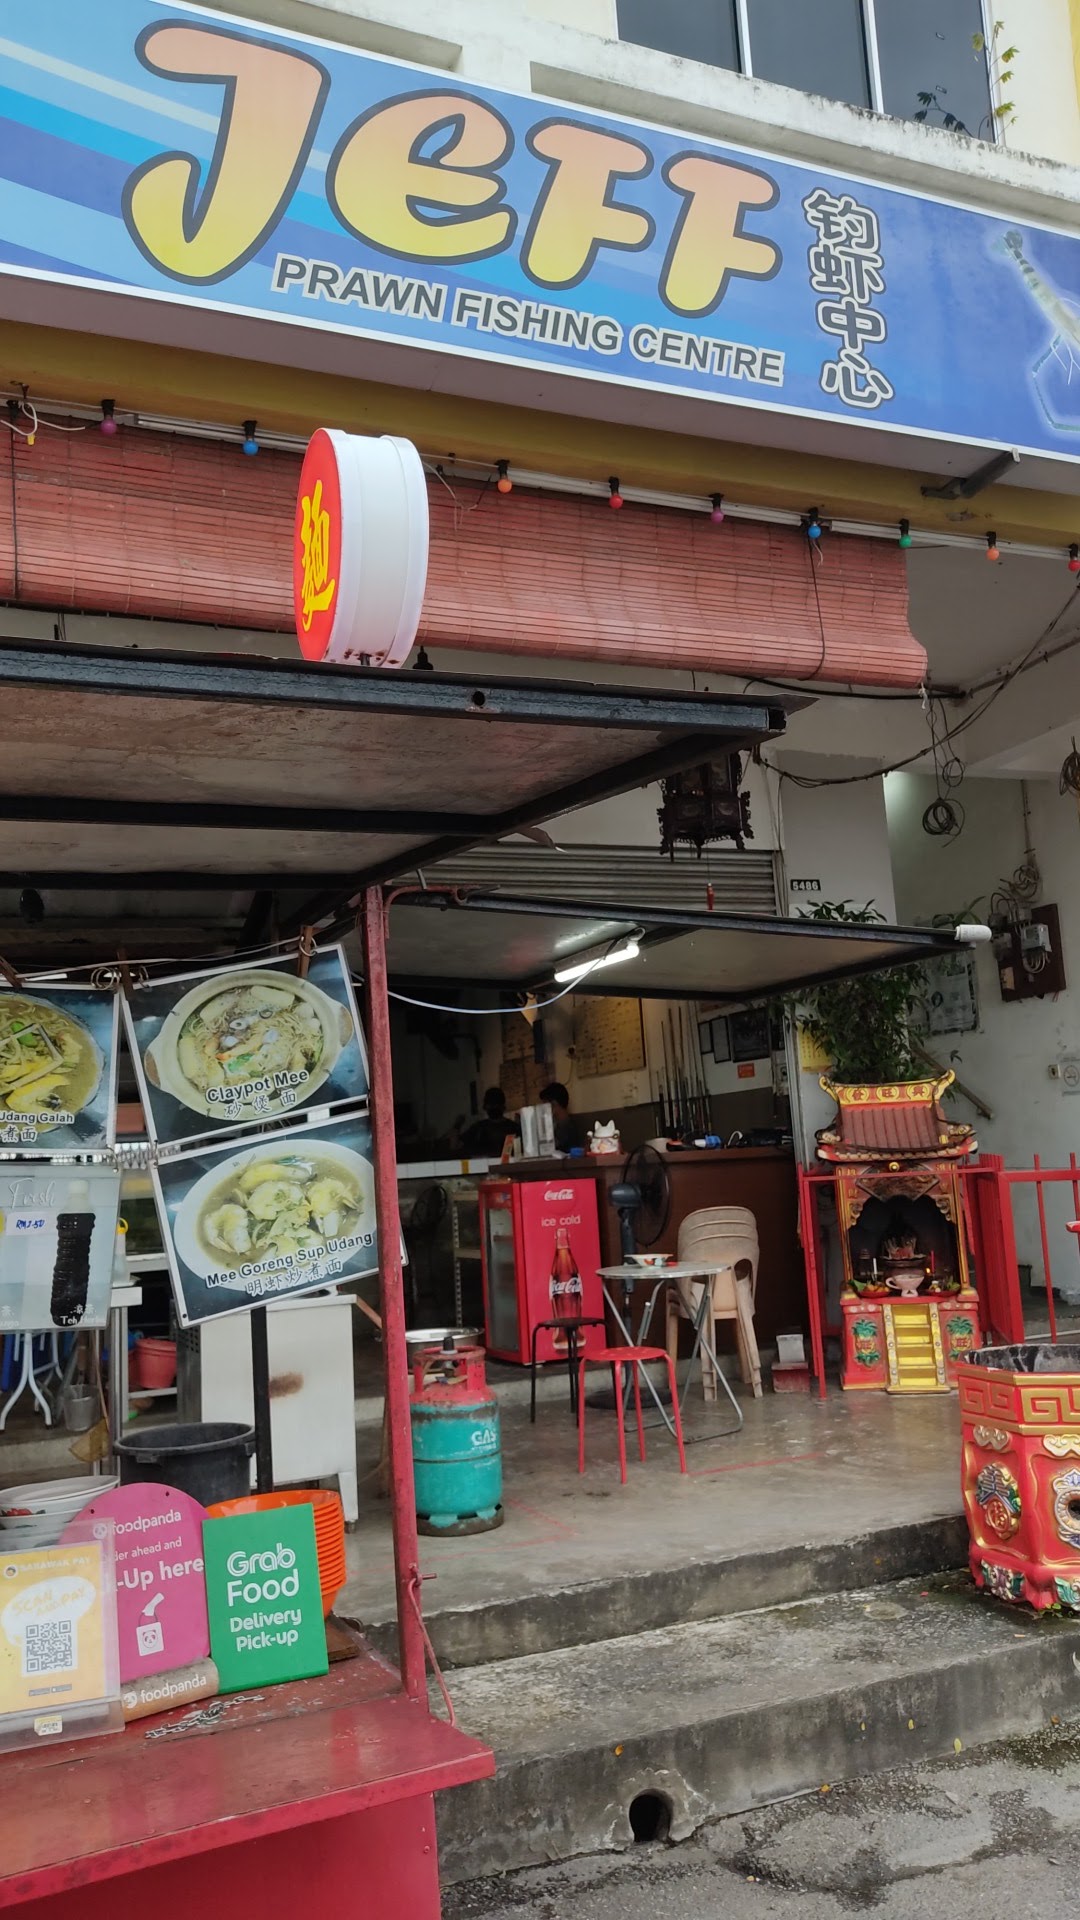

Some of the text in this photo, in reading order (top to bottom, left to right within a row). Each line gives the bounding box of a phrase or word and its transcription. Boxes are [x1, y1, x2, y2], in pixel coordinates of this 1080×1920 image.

[803, 188, 894, 409] 钓虾中心
[273, 255, 785, 387] PRAWN FISHING CENTRE
[792, 880, 819, 890] 5486
[207, 1070, 309, 1102] Claypot Mee
[40, 1113, 73, 1122] Galah
[0, 1126, 36, 1141] 煮面
[542, 1215, 581, 1227] ice cold
[206, 1233, 373, 1287] Mee Goreng Sup Udang
[61, 1315, 77, 1325] Teh
[471, 1429, 497, 1446] GAS
[131, 1543, 162, 1558] ahead
[164, 1537, 182, 1550] and
[159, 1558, 204, 1581] here
[227, 1542, 296, 1577] Grab
[227, 1568, 300, 1607] Food
[229, 1609, 302, 1633] Delivery
[236, 1629, 299, 1652] Pick-up
[140, 1674, 207, 1703] foodpanda
